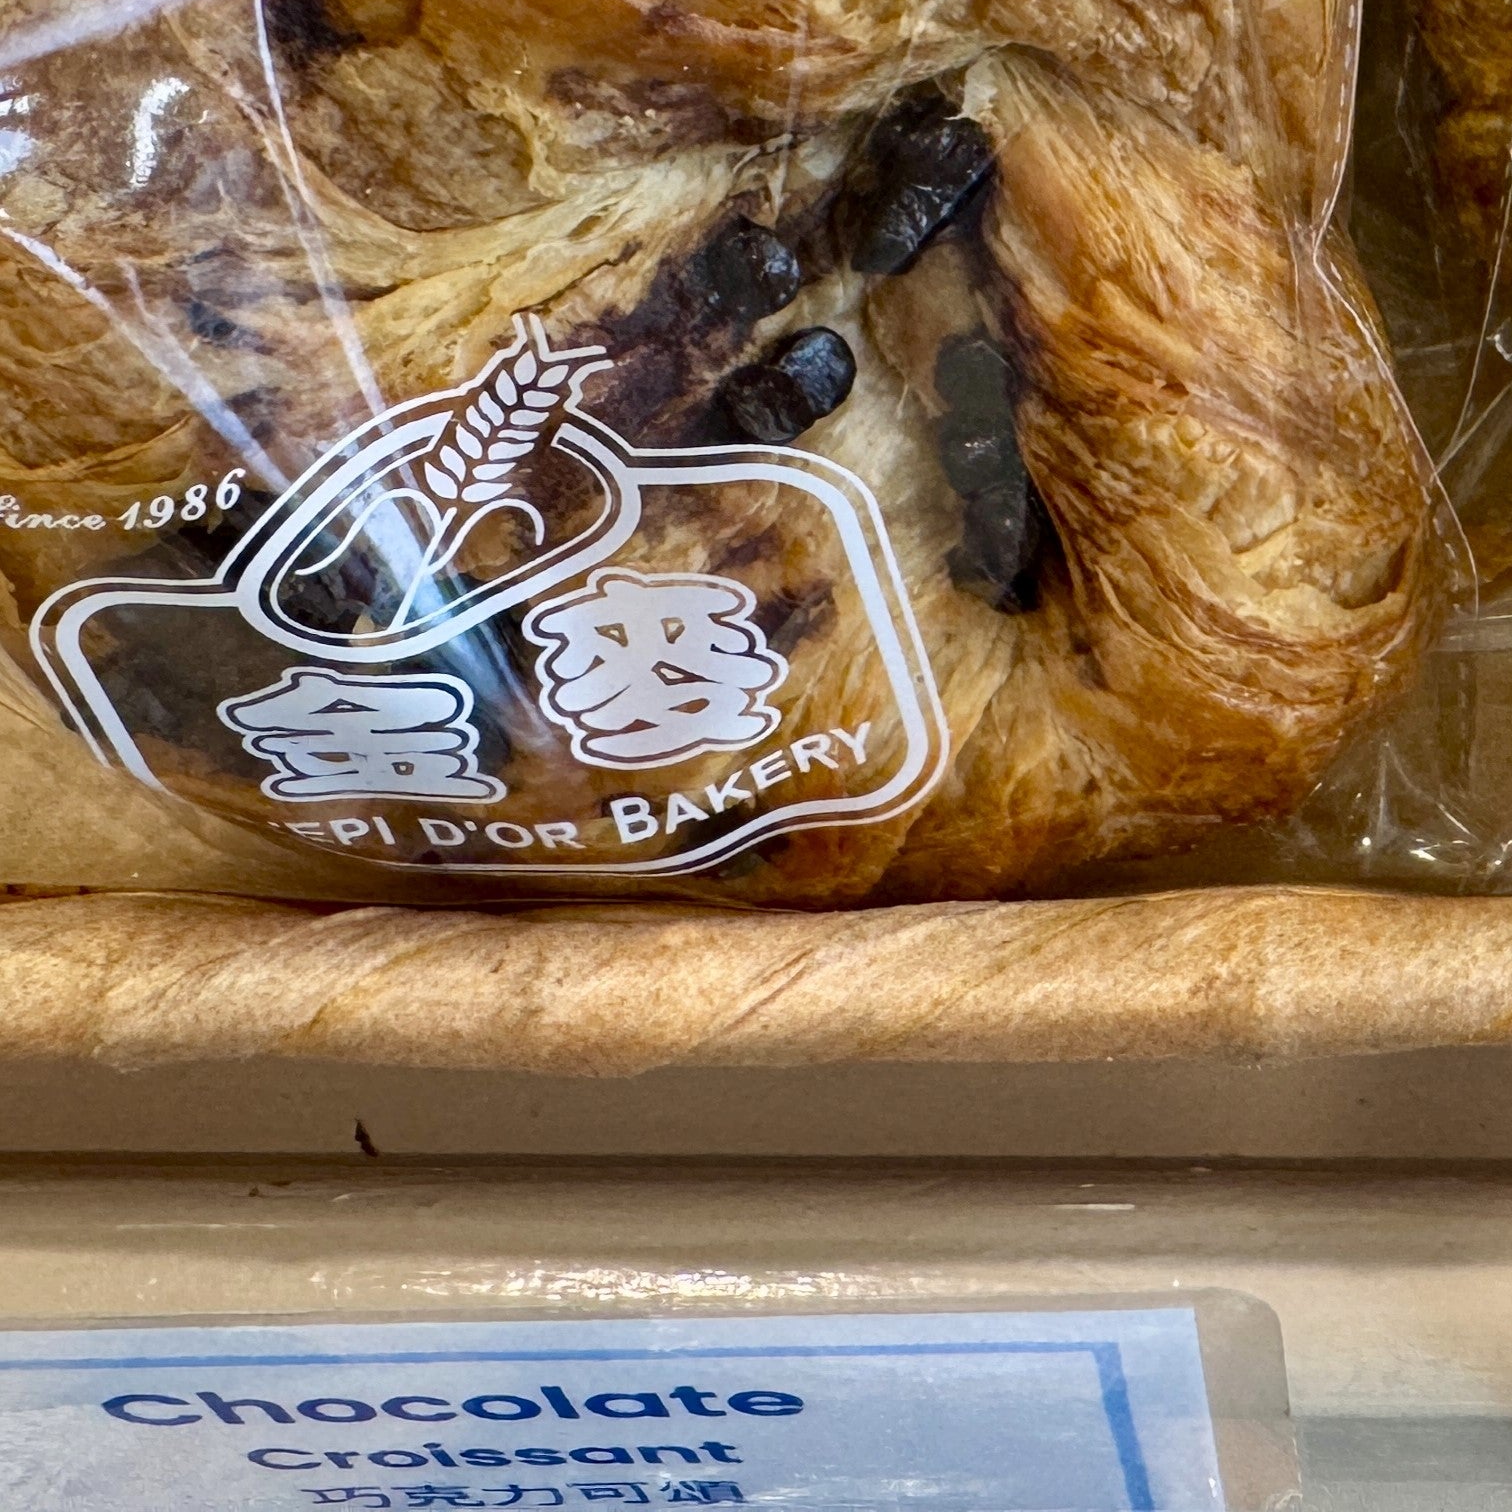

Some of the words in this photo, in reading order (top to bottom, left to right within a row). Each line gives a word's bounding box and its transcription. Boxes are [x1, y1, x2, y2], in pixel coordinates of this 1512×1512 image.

[116, 467, 246, 531] 1986
[418, 817, 587, 849] D'OR
[609, 721, 873, 845] BAKERY
[101, 1385, 805, 1426] Chocolate
[246, 1441, 744, 1470] Croissant
